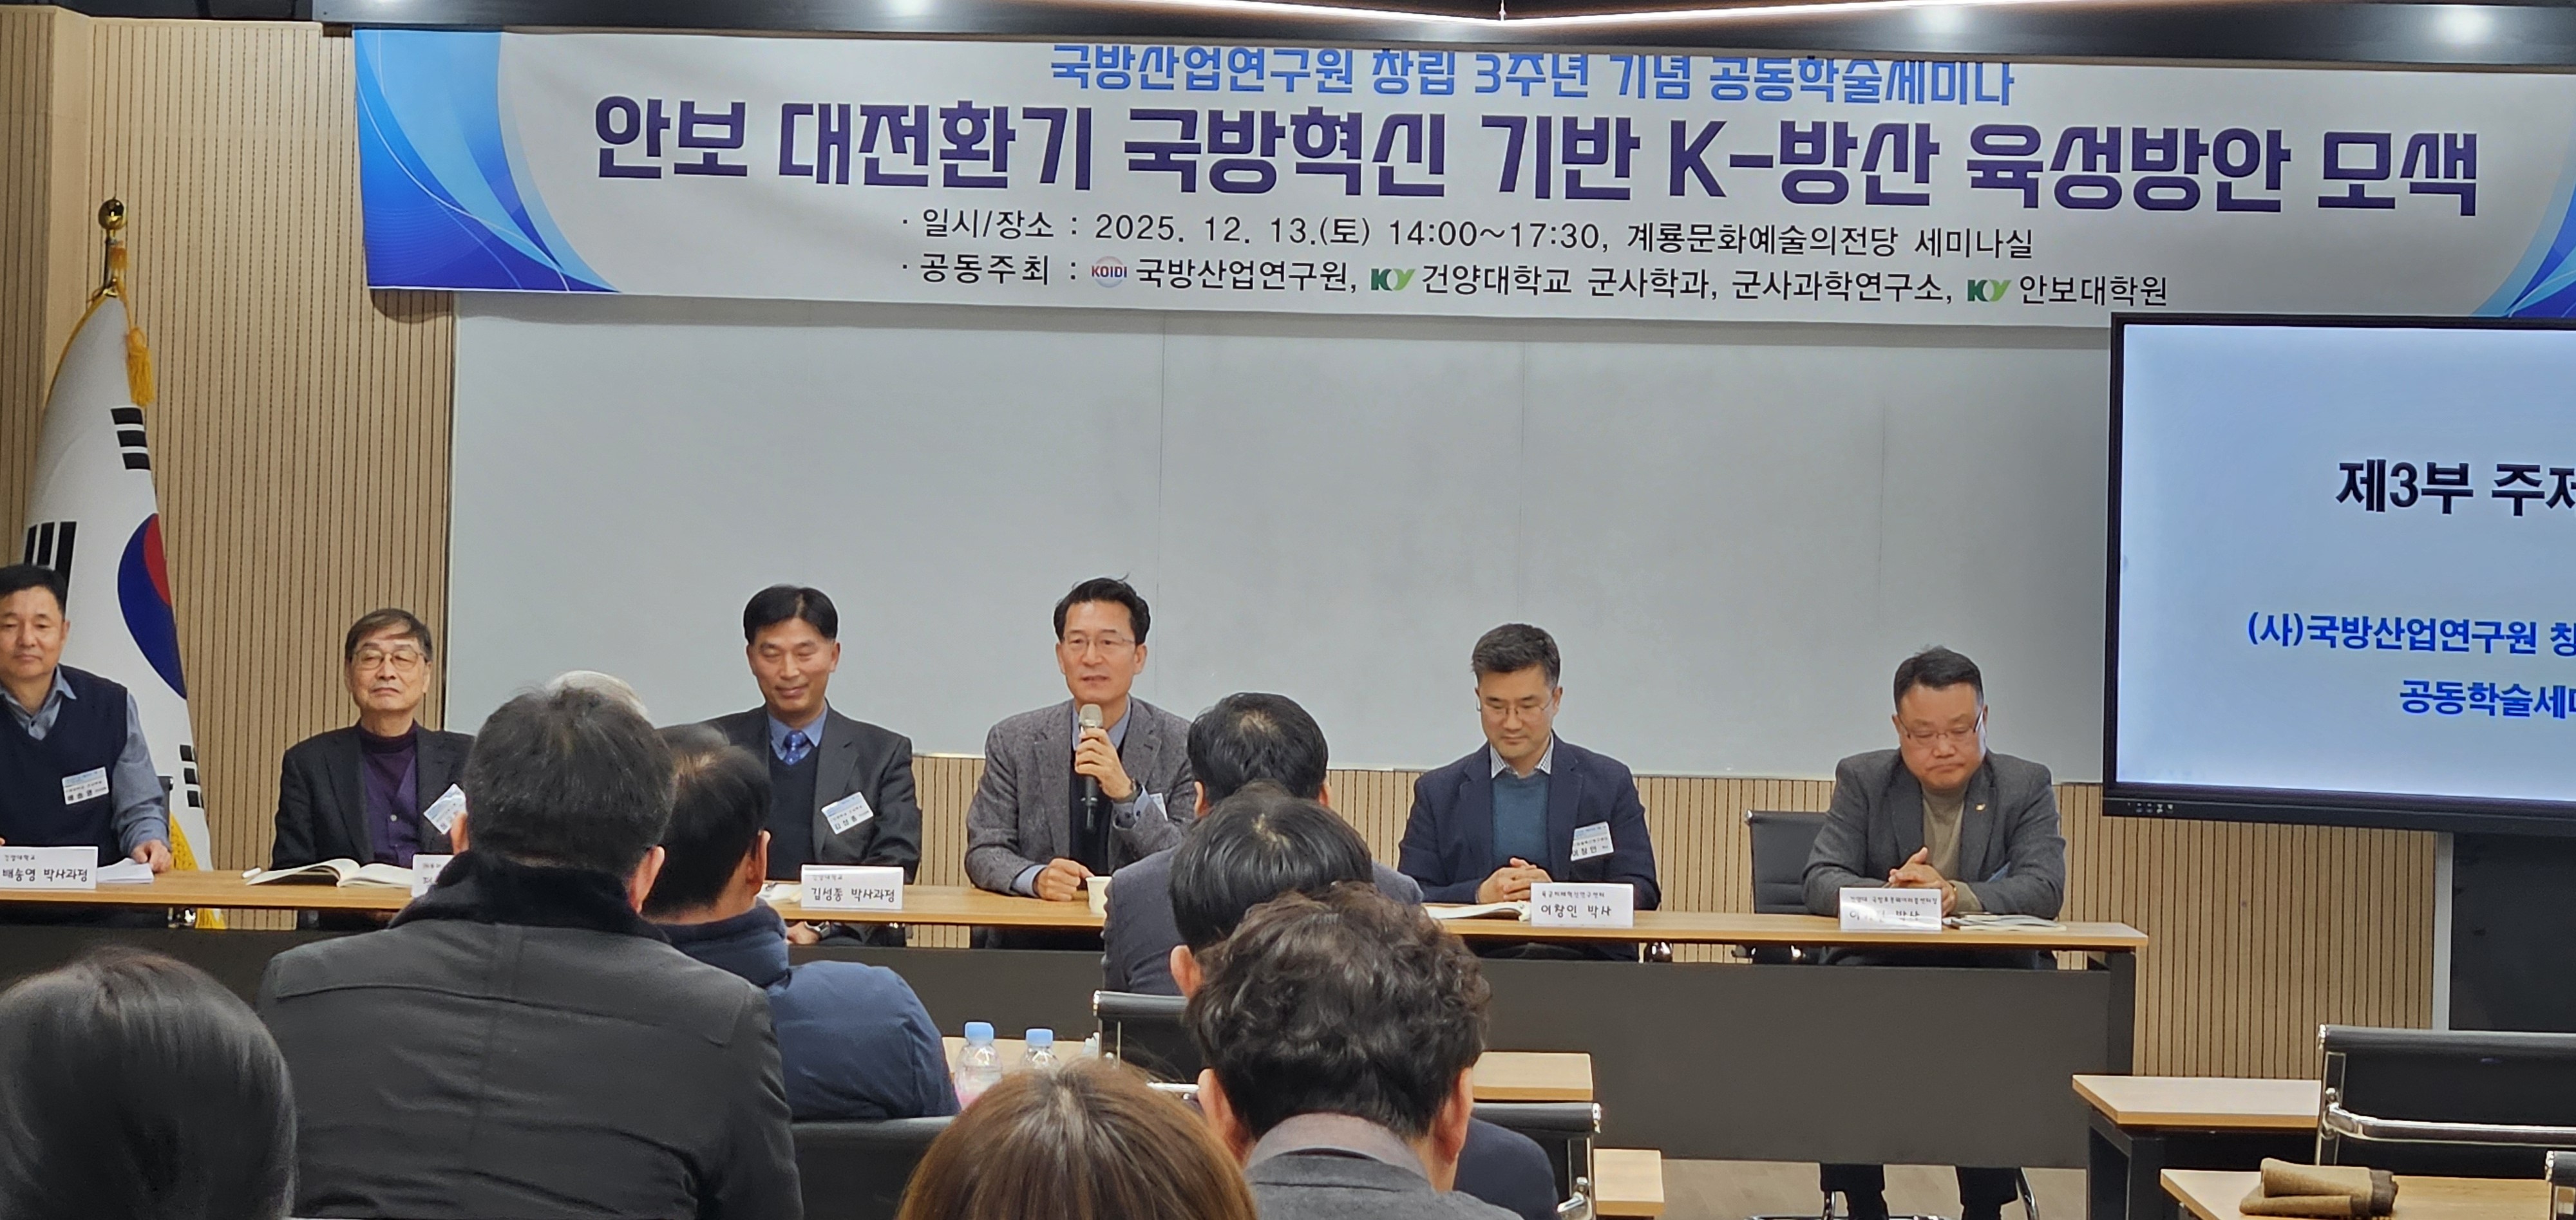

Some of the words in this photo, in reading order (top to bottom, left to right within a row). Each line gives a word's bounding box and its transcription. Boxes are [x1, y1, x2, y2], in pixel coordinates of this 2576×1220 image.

[1050, 44, 1354, 94] 국방산업연구원
[1372, 48, 1456, 95] 창립
[1475, 53, 1589, 99] 3주년
[1609, 54, 1691, 100] 기념
[1709, 56, 2016, 106] 공동학술세미나
[596, 96, 747, 179] 안보
[779, 100, 1092, 191] 대전환기
[1124, 106, 1444, 197] 국방혁신
[1482, 115, 1640, 200] 기반
[1670, 120, 1940, 206] K-방산
[1967, 124, 2291, 212] 육성방안
[2318, 132, 2477, 216] 모색
[923, 209, 1054, 239] 일시/장소
[1095, 214, 1183, 242] 2025.
[1206, 216, 1249, 243] 12.
[1271, 217, 1369, 246] 13.(토)
[1627, 222, 1899, 257] 계룡문화예술의전당
[1915, 228, 2032, 259] 세미나실
[920, 254, 1048, 285] 공동주최
[1092, 266, 1127, 277] KOIDI
[1136, 259, 1356, 293] 국방산업연구원,
[1422, 265, 1571, 296] 건양대학교
[1588, 268, 1716, 300] 군사학과,
[1732, 270, 1951, 305] 군사과학연구소,
[2020, 275, 2166, 306] 안보대학원
[2336, 459, 2474, 514] 제3부
[2249, 612, 2536, 654] (사)국방산업연구원
[2400, 680, 2576, 719] 공동학술세
[43, 868, 88, 882] 박사과정
[851, 888, 895, 903] 박사과정
[1540, 903, 1578, 919] 이창인
[1587, 905, 1612, 919] 박사
